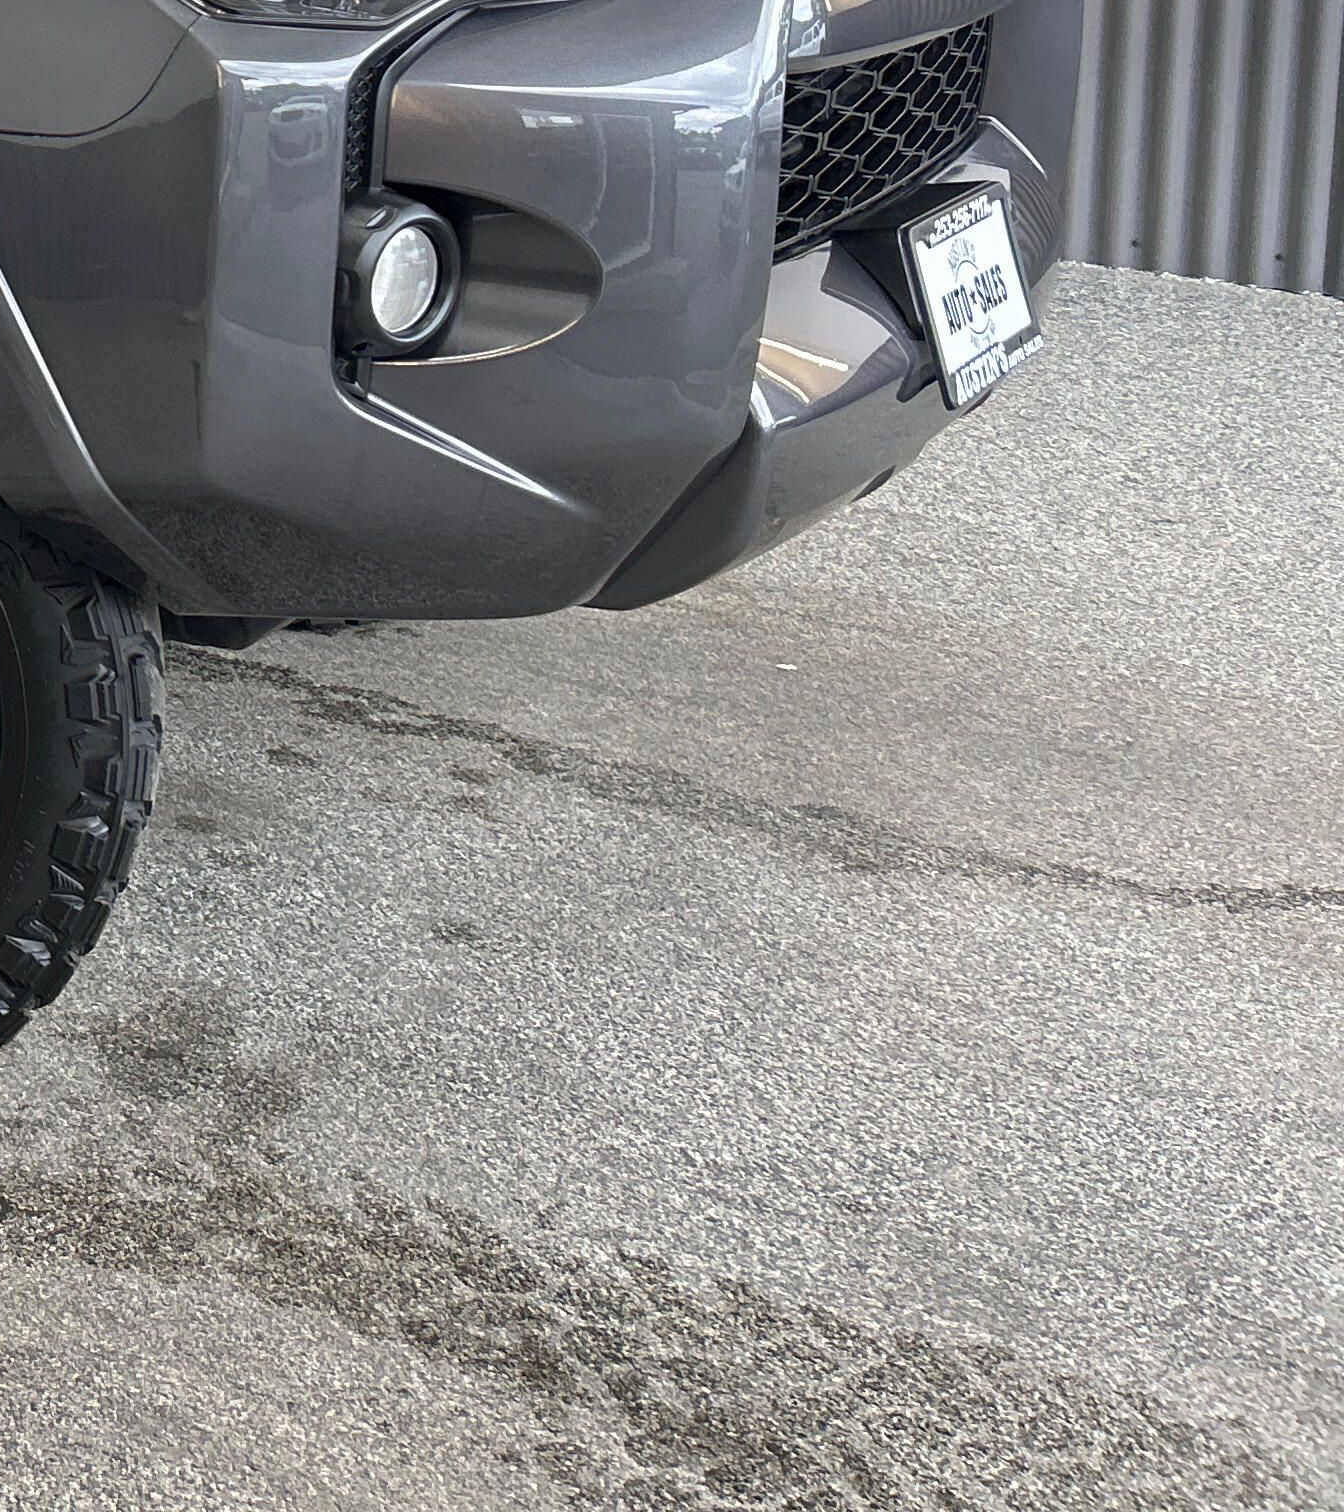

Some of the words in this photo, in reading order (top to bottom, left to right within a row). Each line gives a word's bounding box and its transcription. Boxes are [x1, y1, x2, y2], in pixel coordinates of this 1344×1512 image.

[942, 284, 974, 336] AUTO
[974, 264, 1008, 315] SALES
[955, 342, 1009, 406] AUSTIN'S
